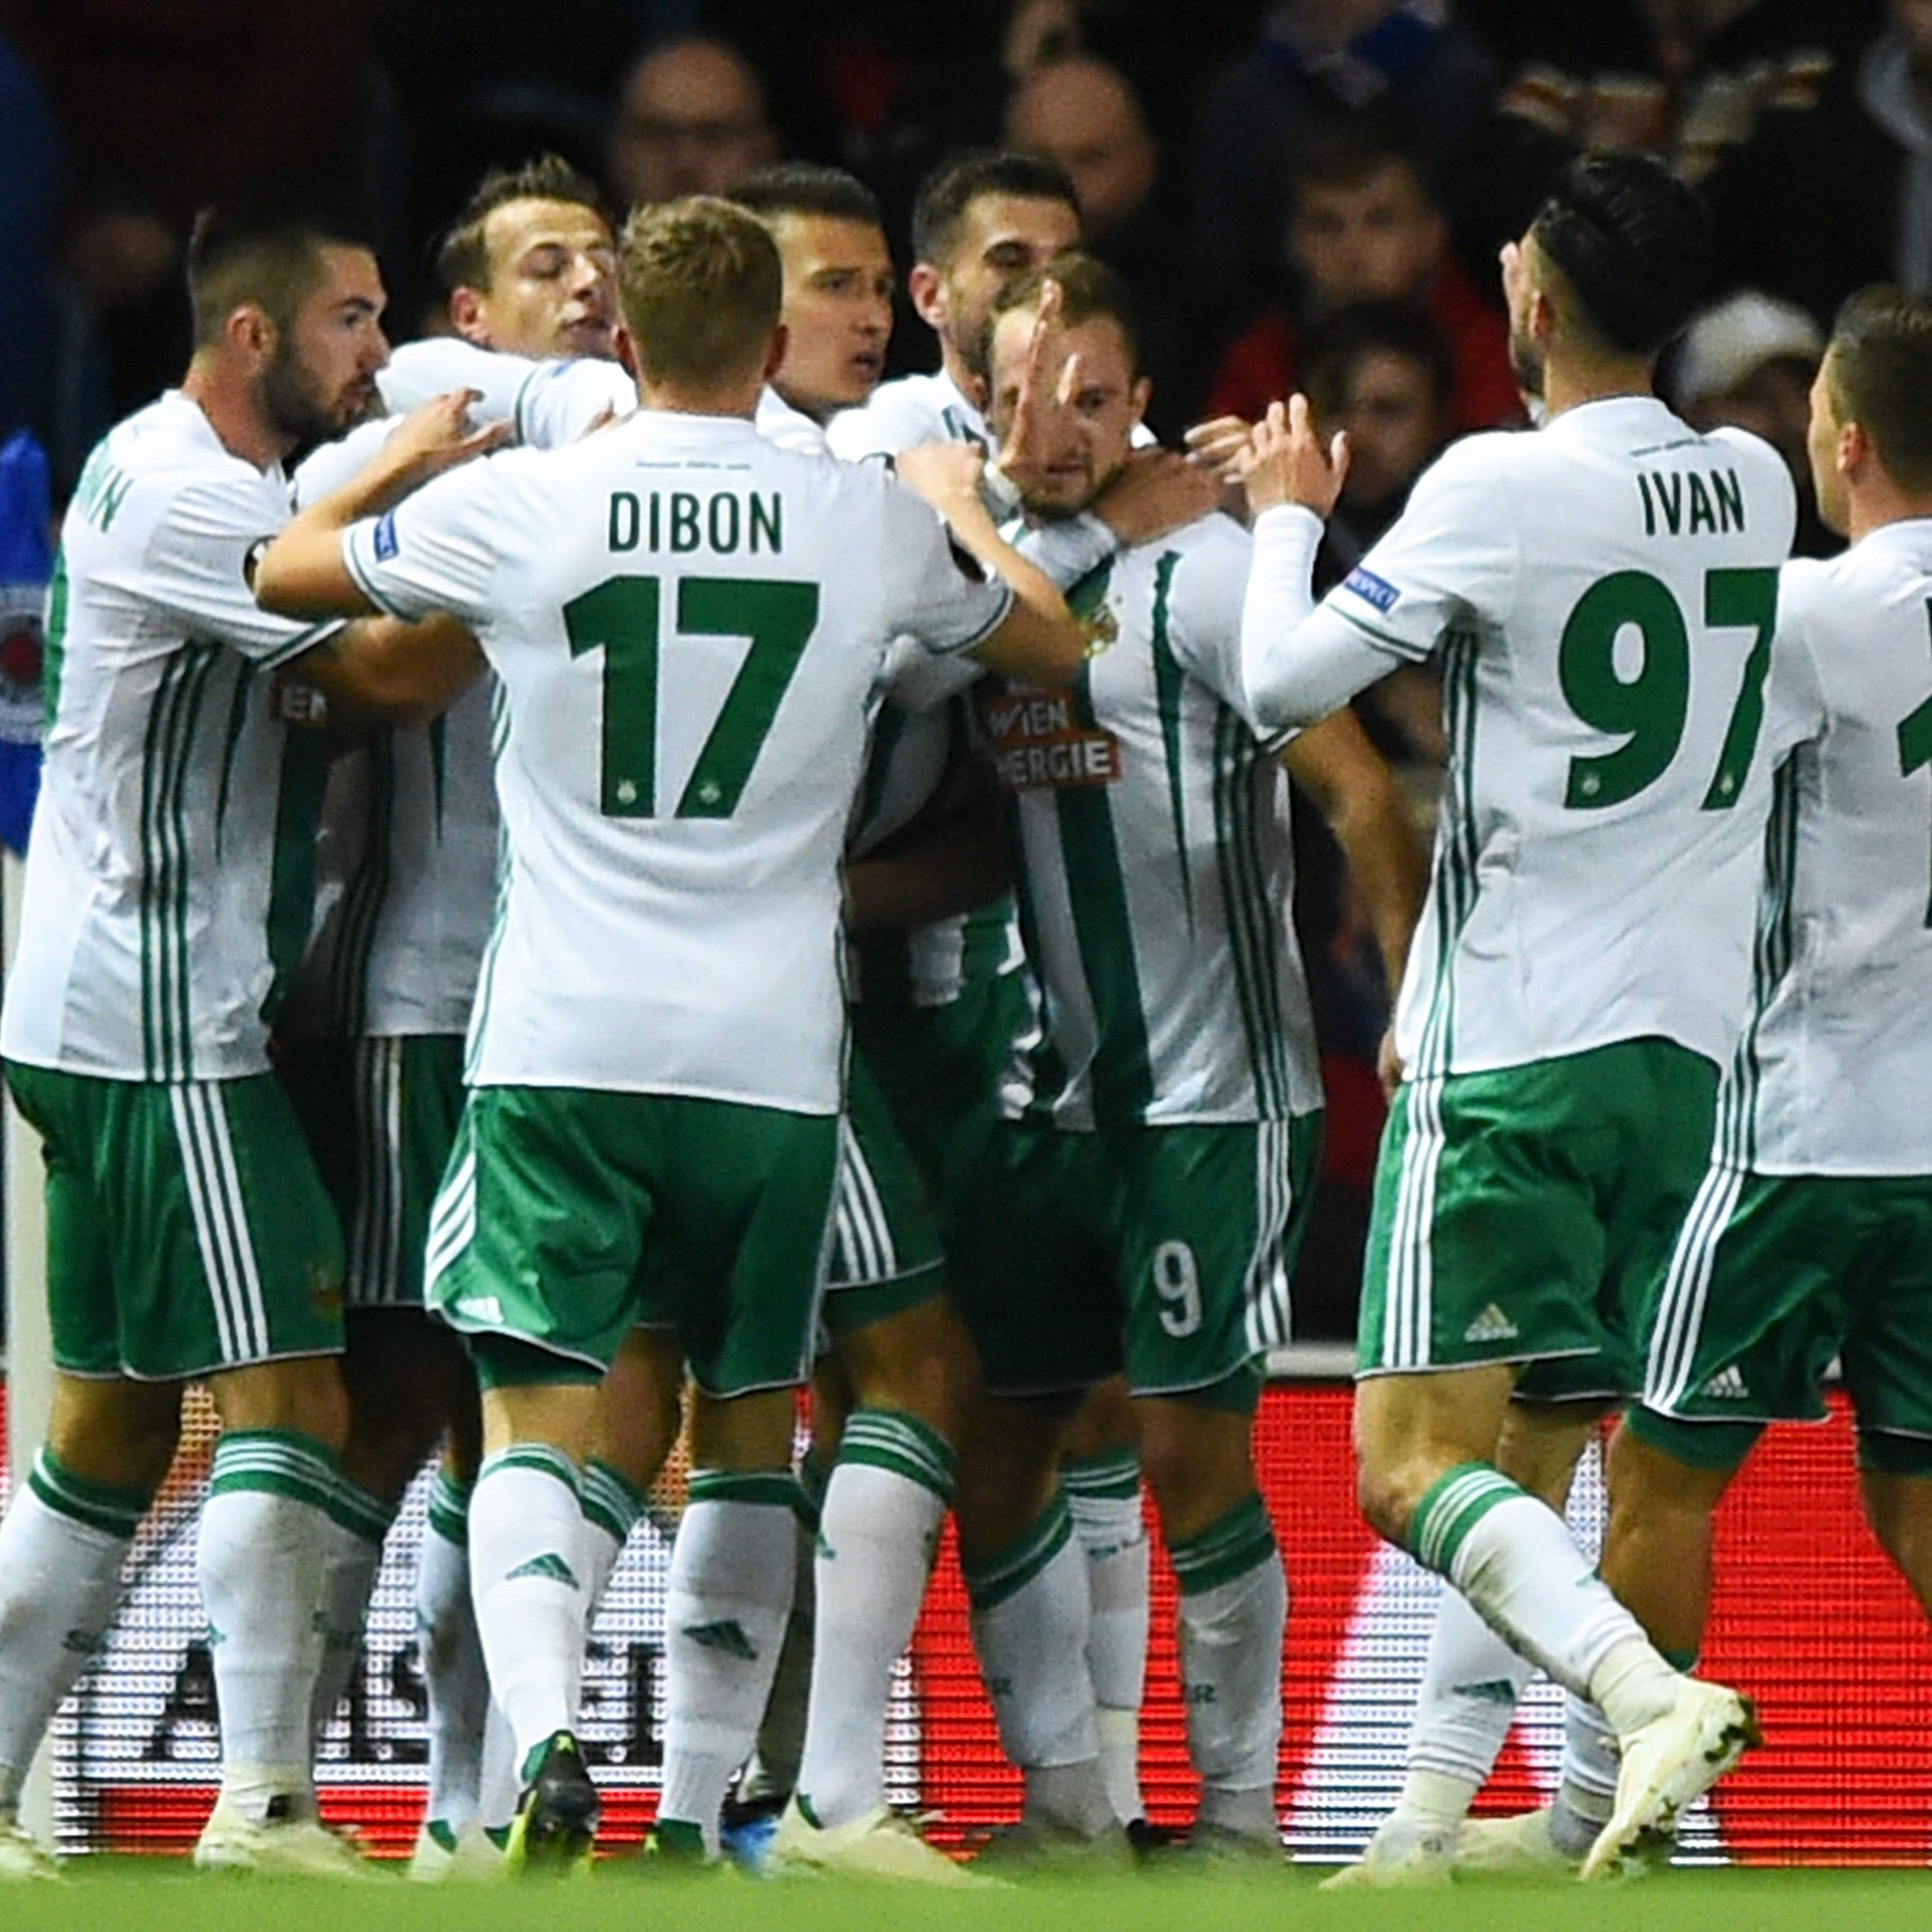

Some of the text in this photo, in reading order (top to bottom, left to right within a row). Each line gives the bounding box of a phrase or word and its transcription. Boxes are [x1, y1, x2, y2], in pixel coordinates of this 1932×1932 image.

[608, 491, 782, 554] DIBON
[1636, 468, 1745, 536] IVAN
[563, 574, 821, 819] 17
[990, 698, 1072, 738] WIEN
[1559, 567, 1780, 811] 97
[1153, 1239, 1202, 1338] 9
